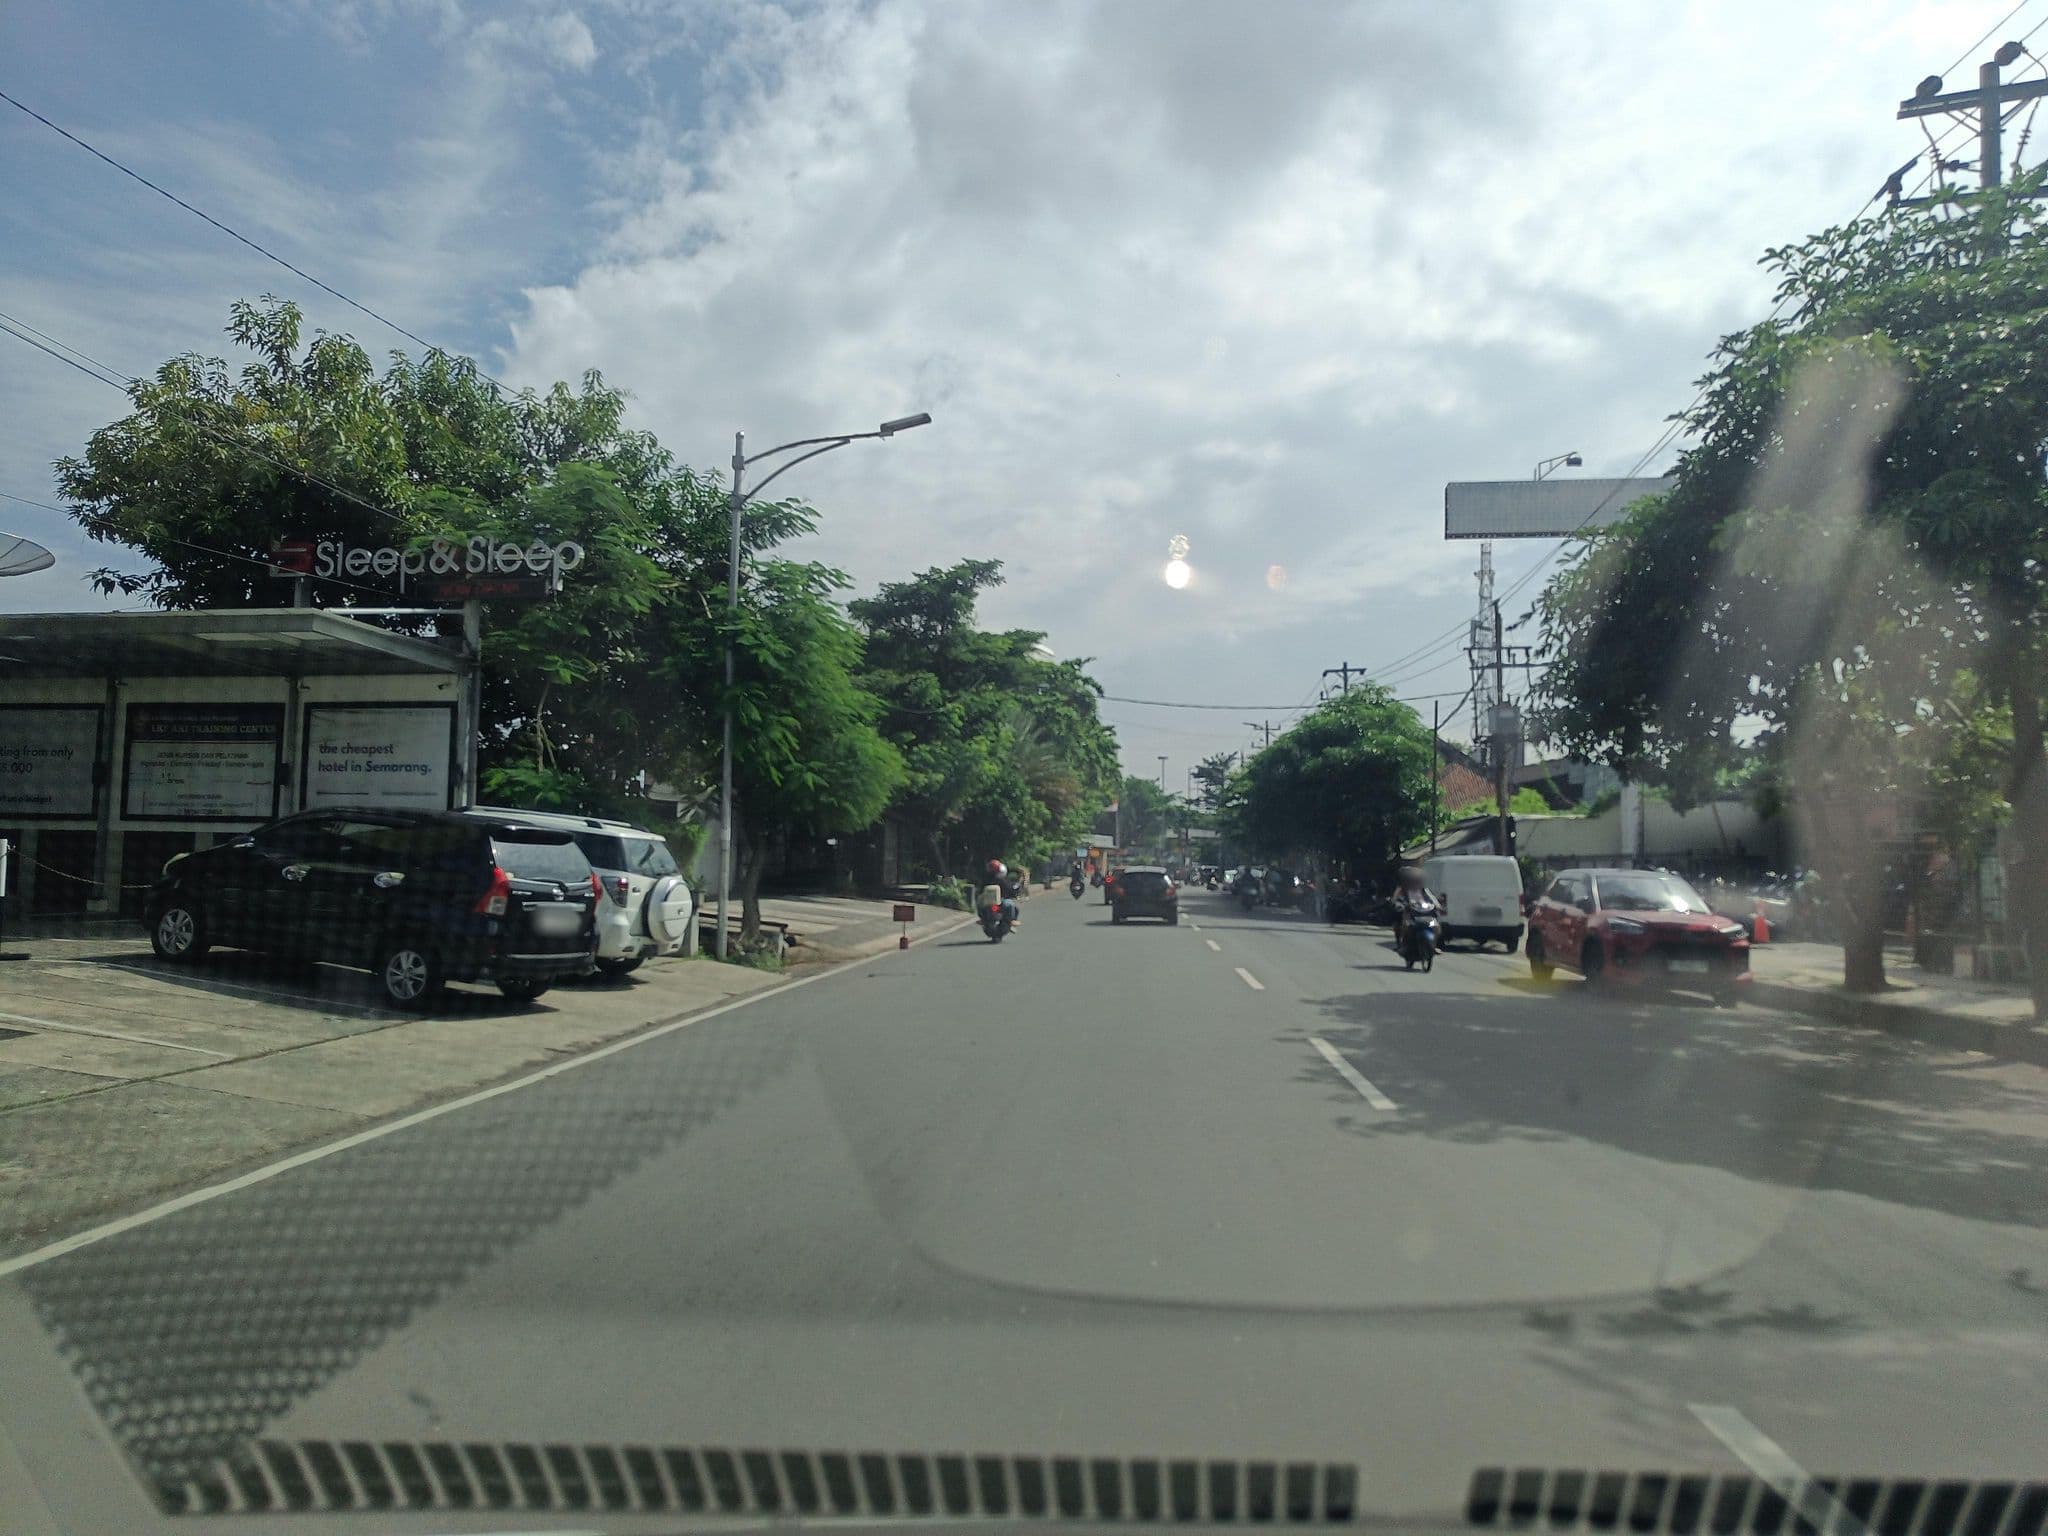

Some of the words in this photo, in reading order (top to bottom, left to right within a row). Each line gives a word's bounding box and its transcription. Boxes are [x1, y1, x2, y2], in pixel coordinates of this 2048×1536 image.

[315, 541, 425, 594] Sleep
[429, 540, 461, 573] &
[466, 536, 585, 592] Sleep
[23, 745, 48, 757] from
[50, 745, 74, 761] only
[320, 742, 338, 755] the
[341, 742, 394, 757] cheapest
[318, 760, 348, 772] hotel
[350, 760, 362, 772] in
[365, 760, 432, 776] Semarang.
